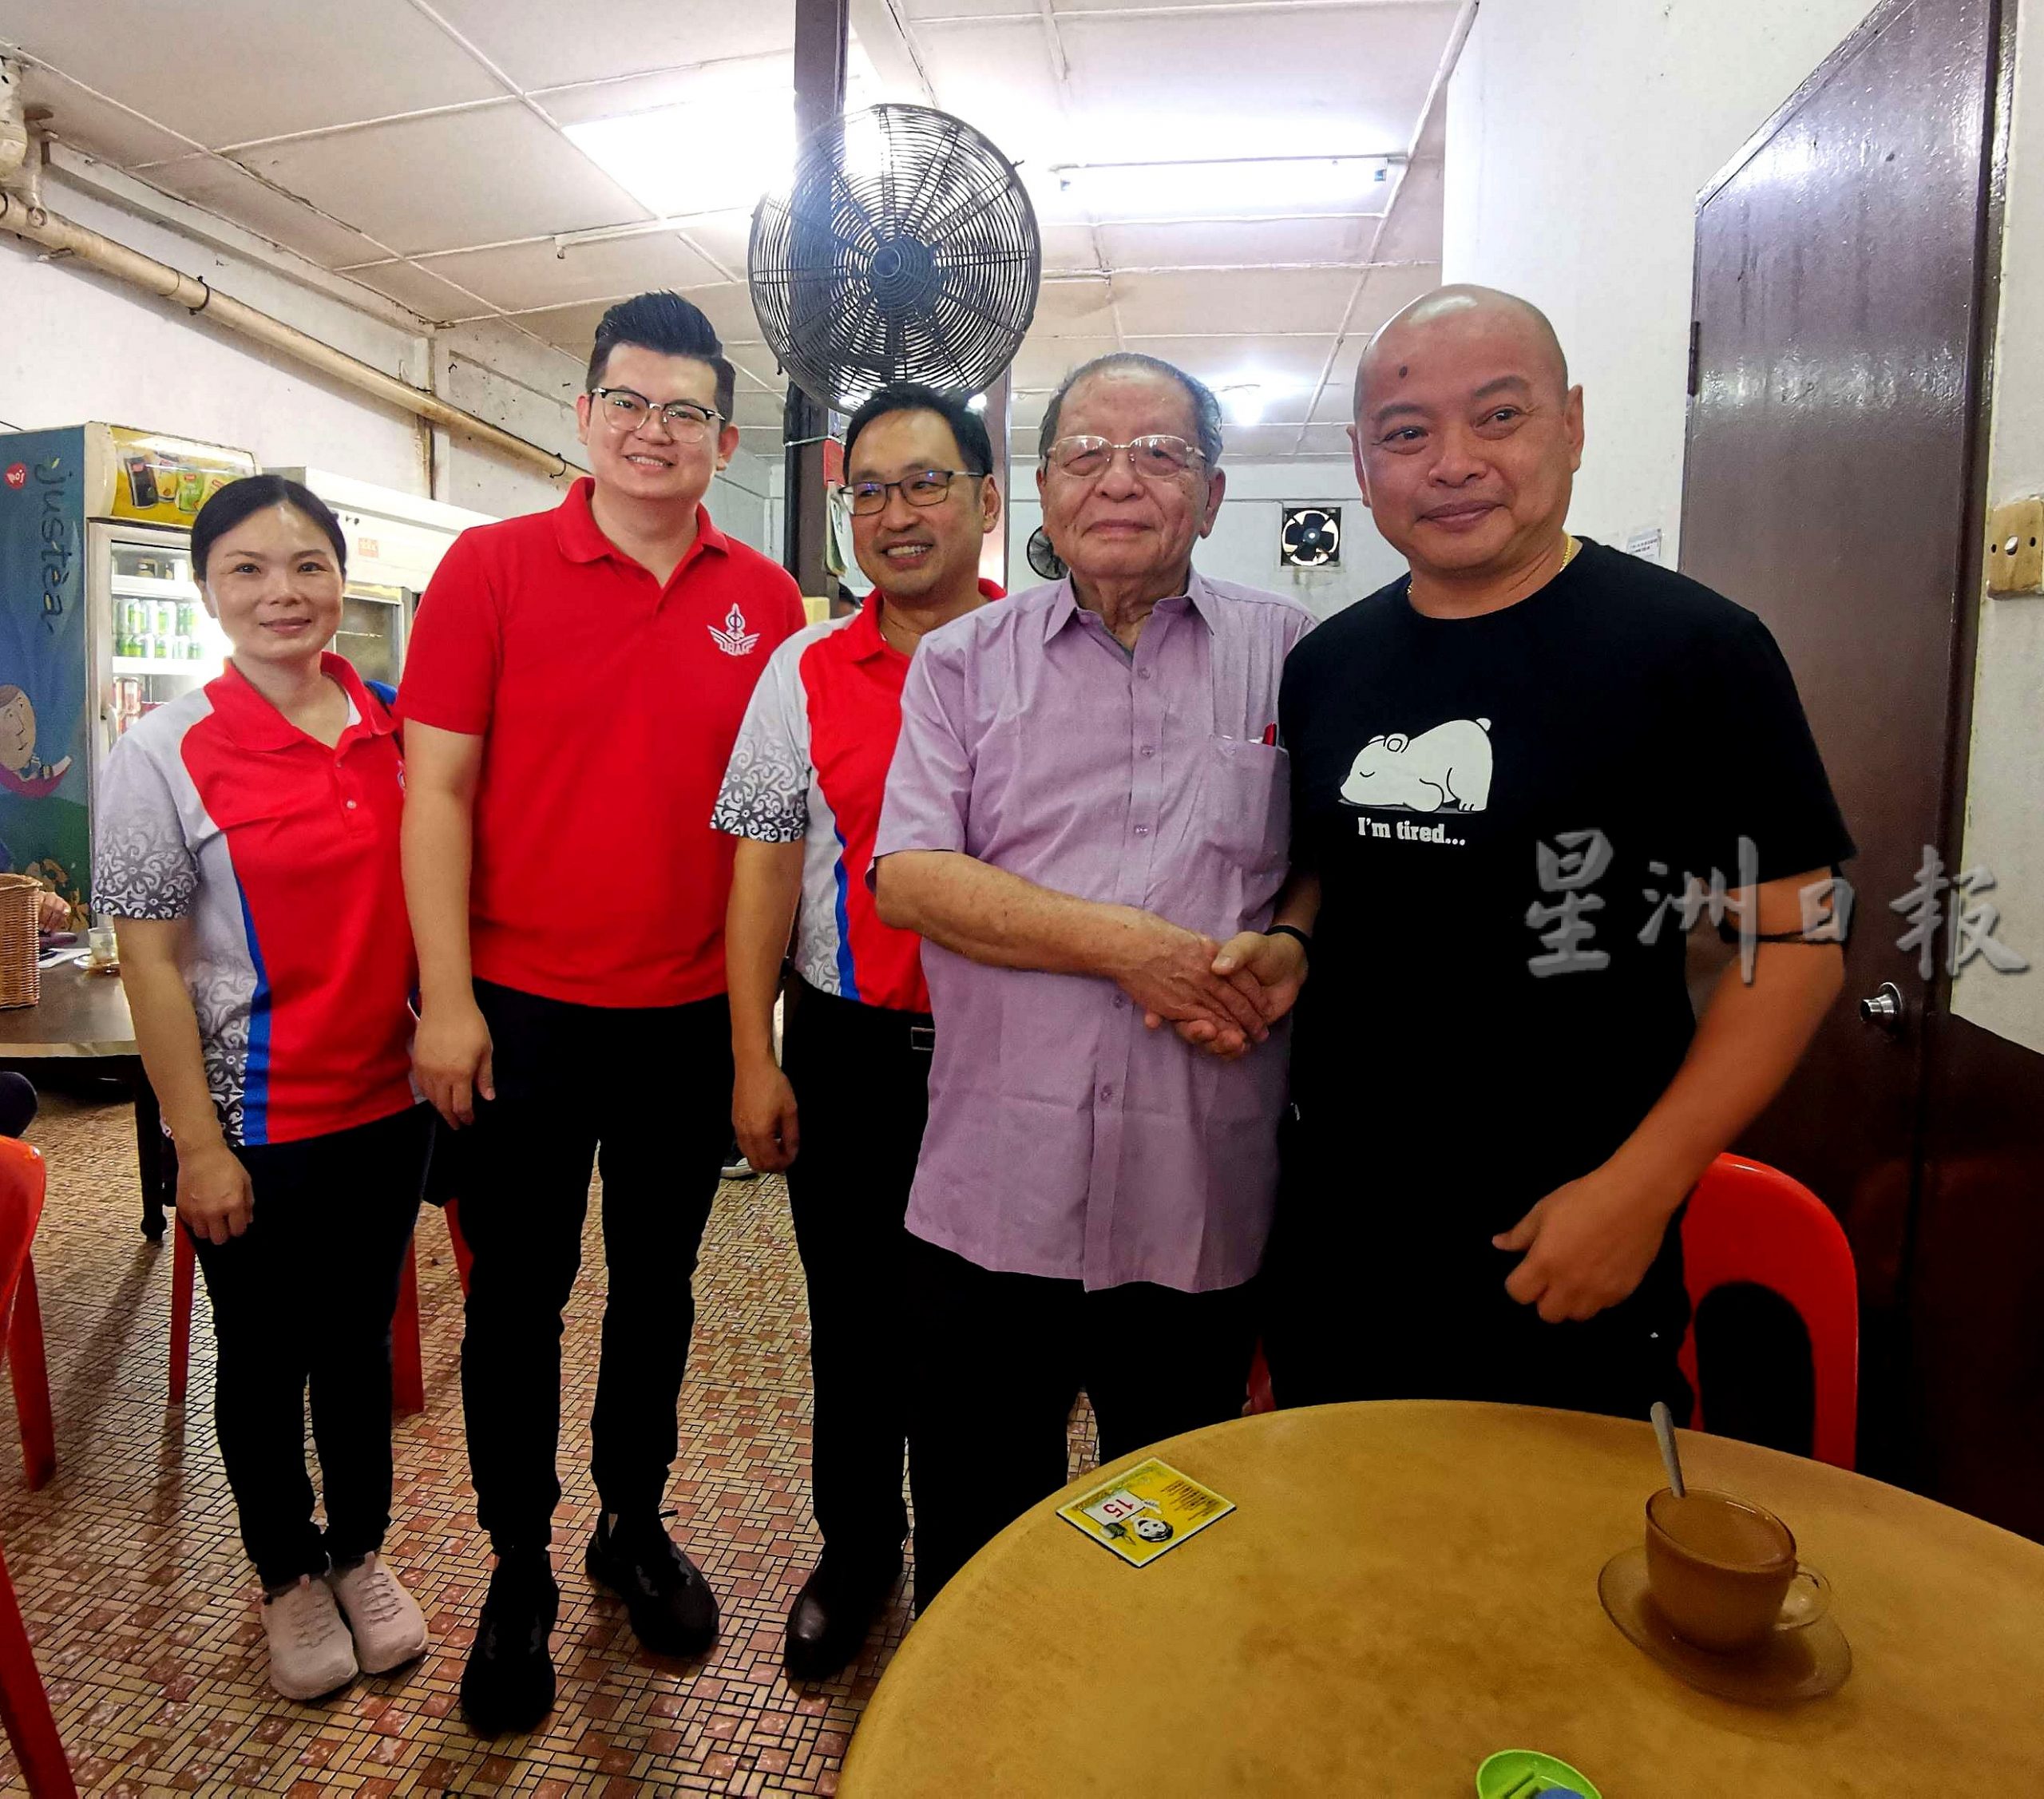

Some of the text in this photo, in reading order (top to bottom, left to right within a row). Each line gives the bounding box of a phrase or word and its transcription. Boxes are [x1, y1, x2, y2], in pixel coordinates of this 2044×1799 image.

[1357, 817, 1466, 846] I'm tired...
[1102, 1498, 1135, 1519] 15
